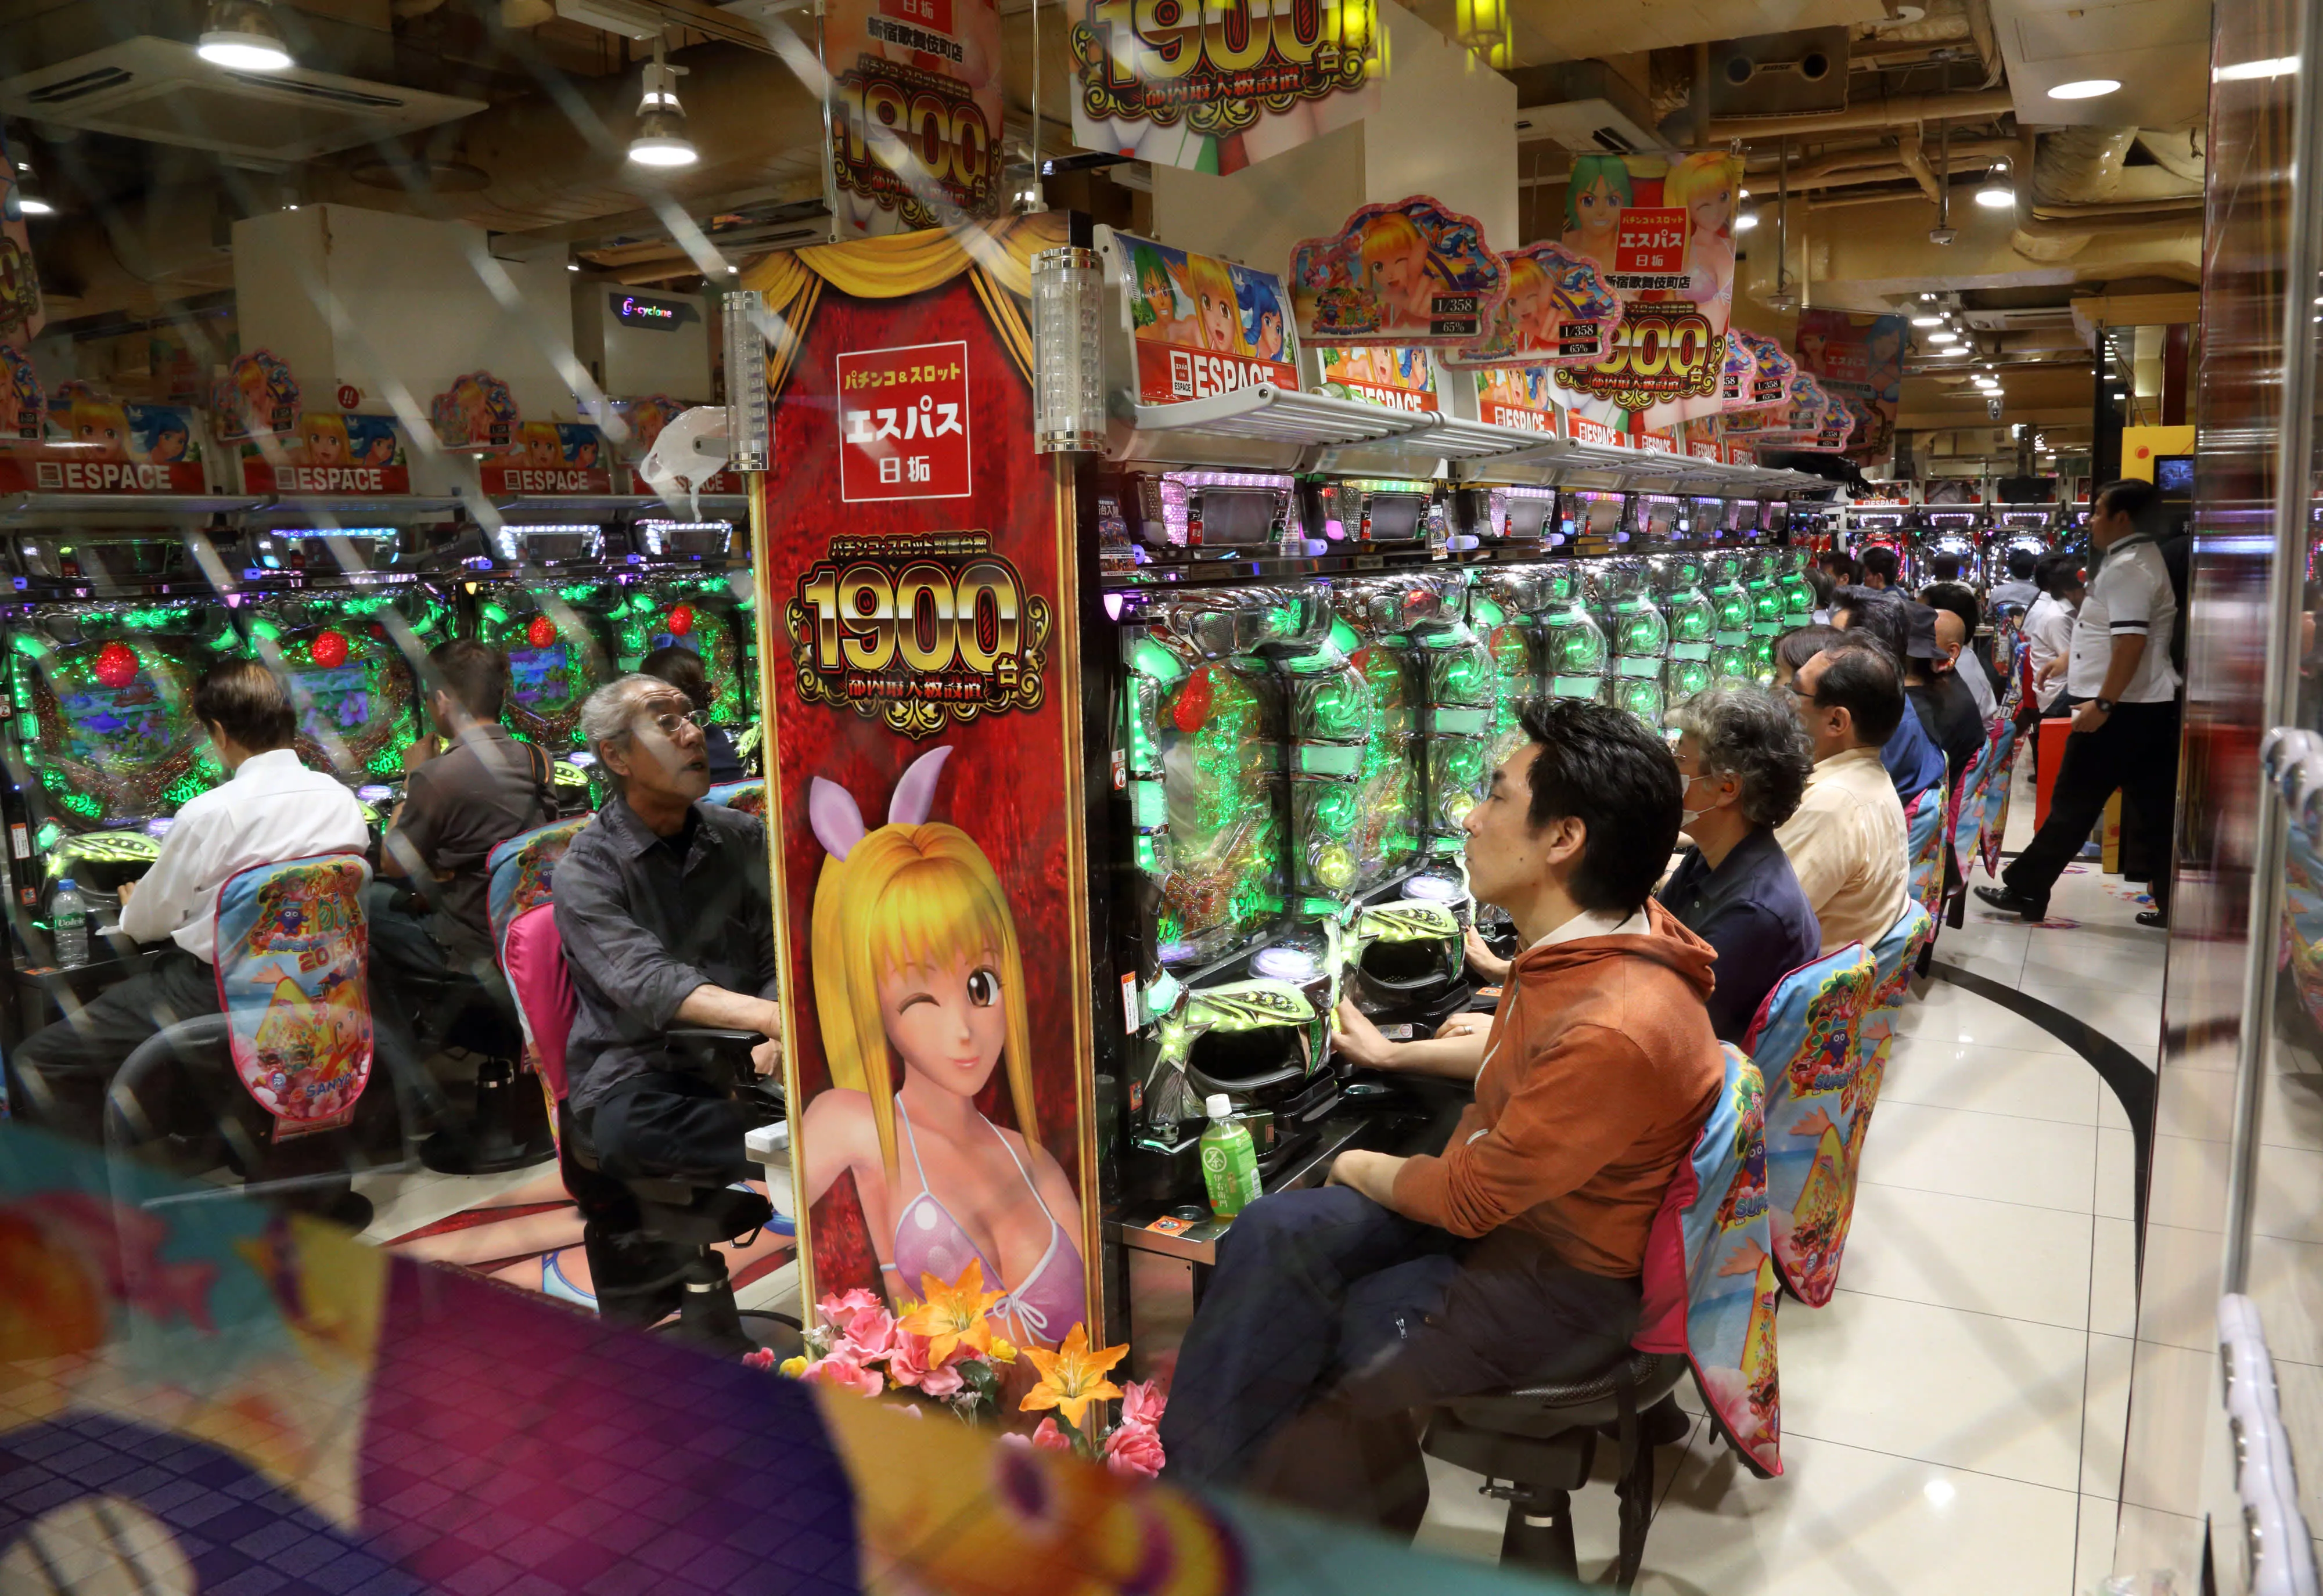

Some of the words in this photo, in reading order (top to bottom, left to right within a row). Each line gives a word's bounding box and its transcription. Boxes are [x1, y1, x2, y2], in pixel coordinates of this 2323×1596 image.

[868, 17, 963, 63] 新宿歌舞伎町店
[839, 79, 987, 189] 1900
[1620, 229, 1682, 248] エスパス
[623, 297, 673, 318] G-cyclone
[1437, 298, 1472, 313] 1/358
[1443, 322, 1465, 333] 65%
[1565, 325, 1594, 337] 1/358
[1570, 344, 1588, 354] 65%
[1574, 318, 1707, 376] 900
[845, 362, 961, 390] パチンコ&スロット
[1174, 381, 1191, 392] ESPACE
[1758, 380, 1778, 390] 1/358
[846, 395, 962, 444] エスパス
[1506, 408, 1545, 432] ESPACE
[1586, 424, 1616, 446] ESPACE
[66, 463, 172, 489] ESPACE
[298, 467, 383, 491] ESPACE
[522, 470, 588, 490] ESPACE
[880, 456, 930, 483] 日拓
[805, 564, 1020, 675] 1900
[998, 657, 1019, 684] 台
[306, 1073, 352, 1098] SANYO
